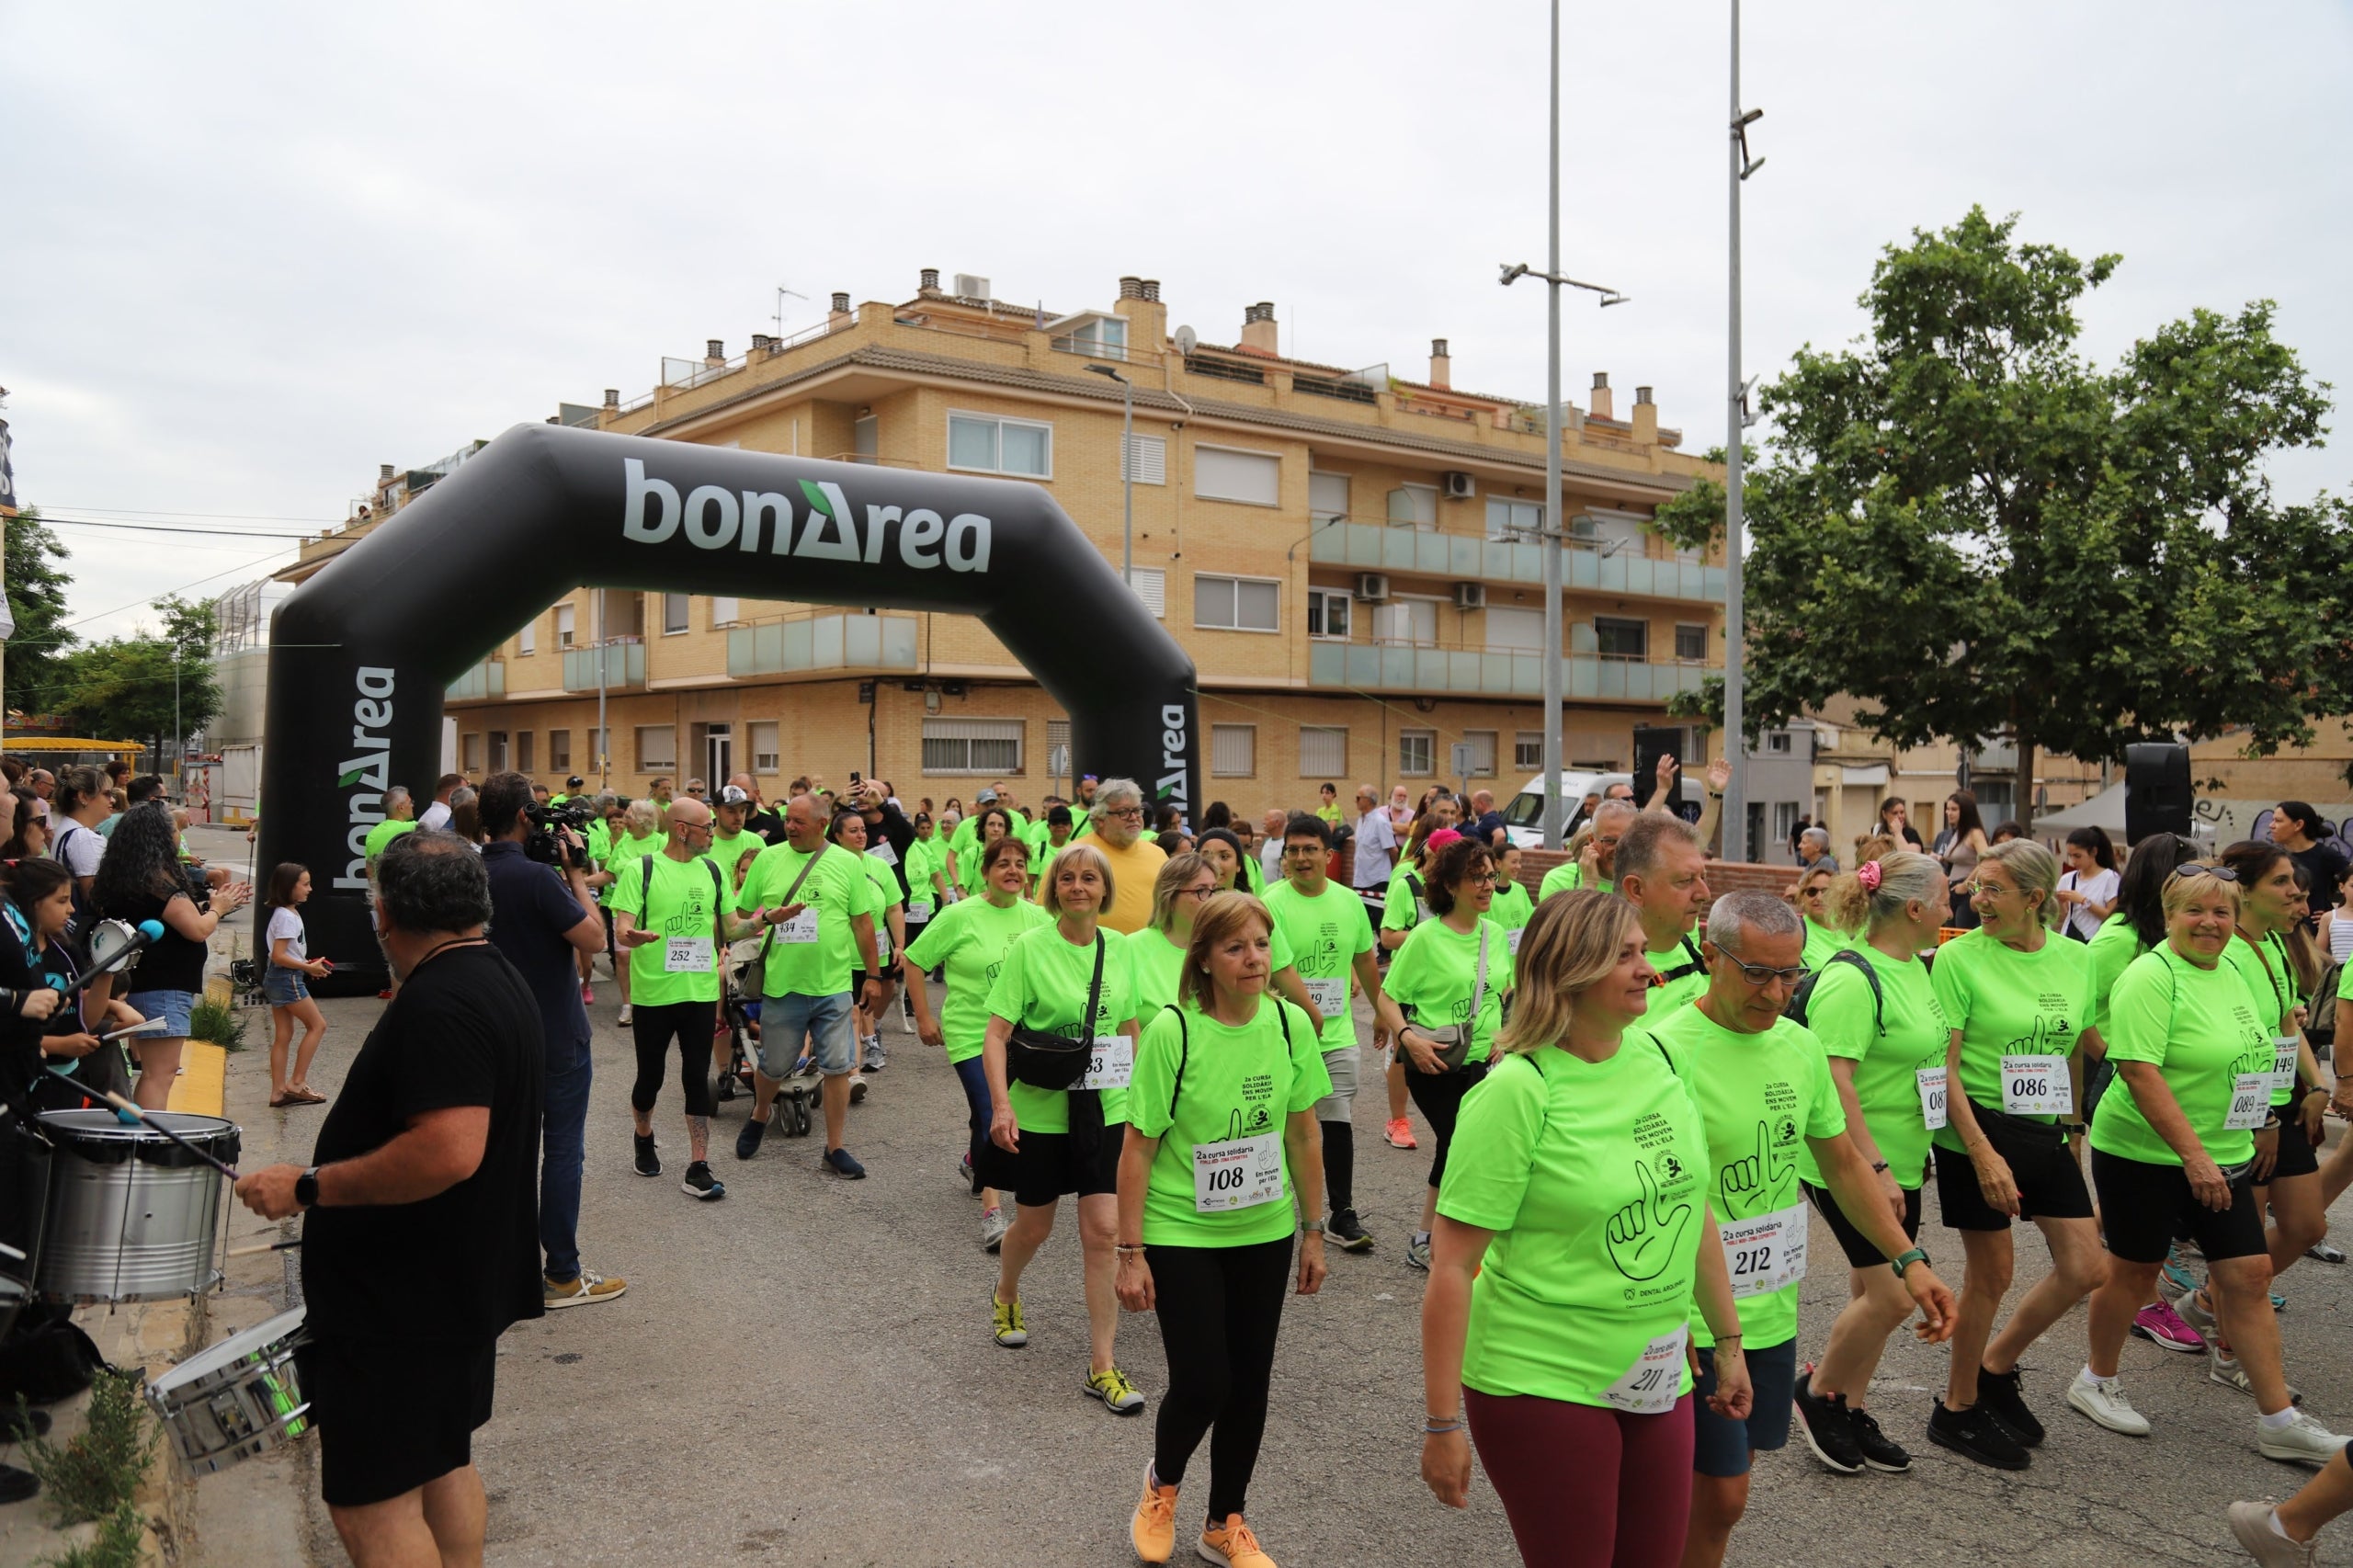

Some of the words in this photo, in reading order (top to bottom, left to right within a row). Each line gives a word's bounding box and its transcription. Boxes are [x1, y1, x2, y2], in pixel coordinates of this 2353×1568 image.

[623, 458, 992, 573] bonArea
[671, 950, 690, 961] 252
[2004, 1061, 2013, 1069] 2a
[2273, 1056, 2294, 1073] 149
[2012, 1078, 2047, 1096] 086
[2234, 1095, 2255, 1113] 089
[1643, 1112, 1662, 1123] CURSA
[1634, 1134, 1648, 1143] ENS
[1648, 1127, 1673, 1139] MOVEM
[1641, 1141, 1655, 1149] PER
[1196, 1151, 1207, 1160] 2a
[1208, 1151, 1226, 1159] cursa
[1209, 1166, 1244, 1191] 108
[1722, 1231, 1733, 1241] 2a
[1735, 1229, 1755, 1239] cursa
[1734, 1246, 1771, 1276] 212
[1630, 1368, 1665, 1392] 211
